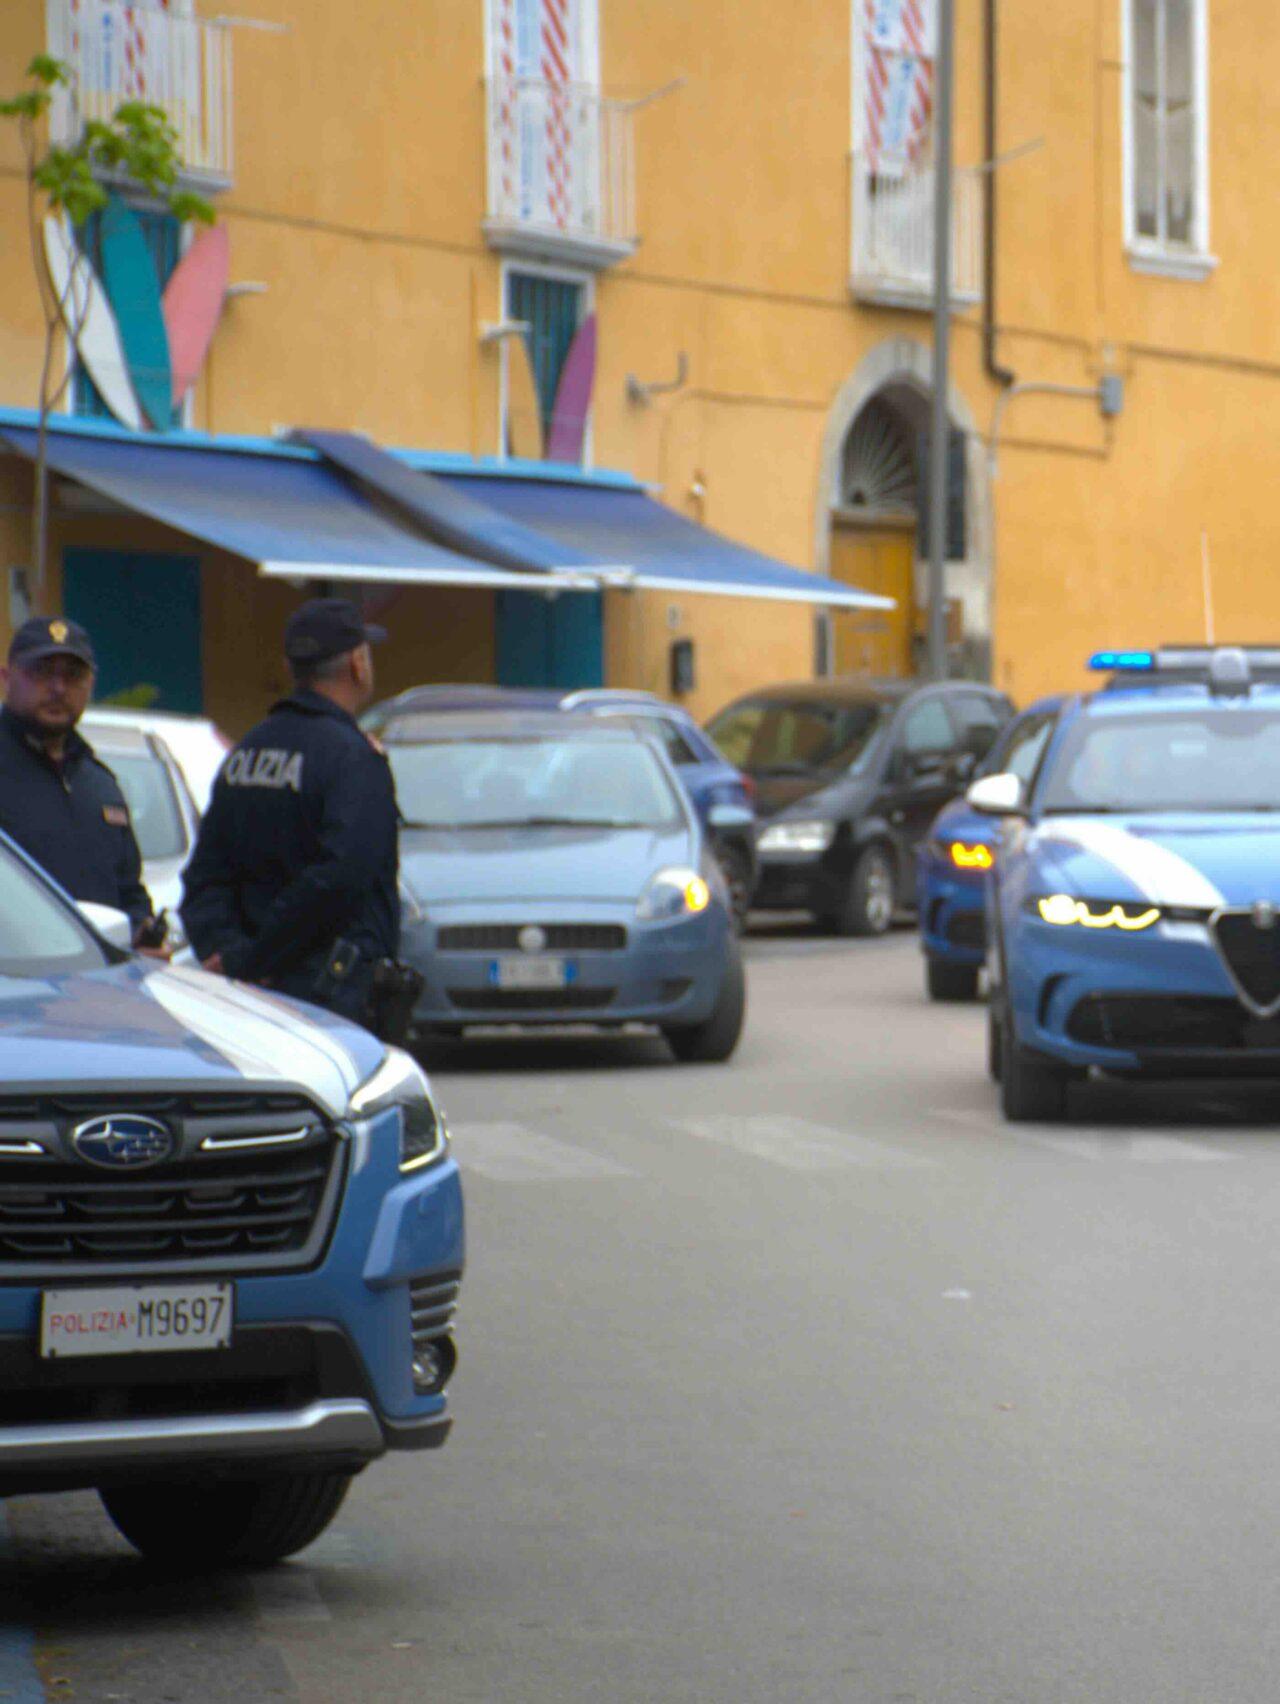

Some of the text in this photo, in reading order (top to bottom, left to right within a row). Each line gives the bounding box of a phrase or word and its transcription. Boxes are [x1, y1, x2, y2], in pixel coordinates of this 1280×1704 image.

[224, 748, 303, 792] OLIZIA
[50, 1296, 225, 1338] POLIZIA M9697
